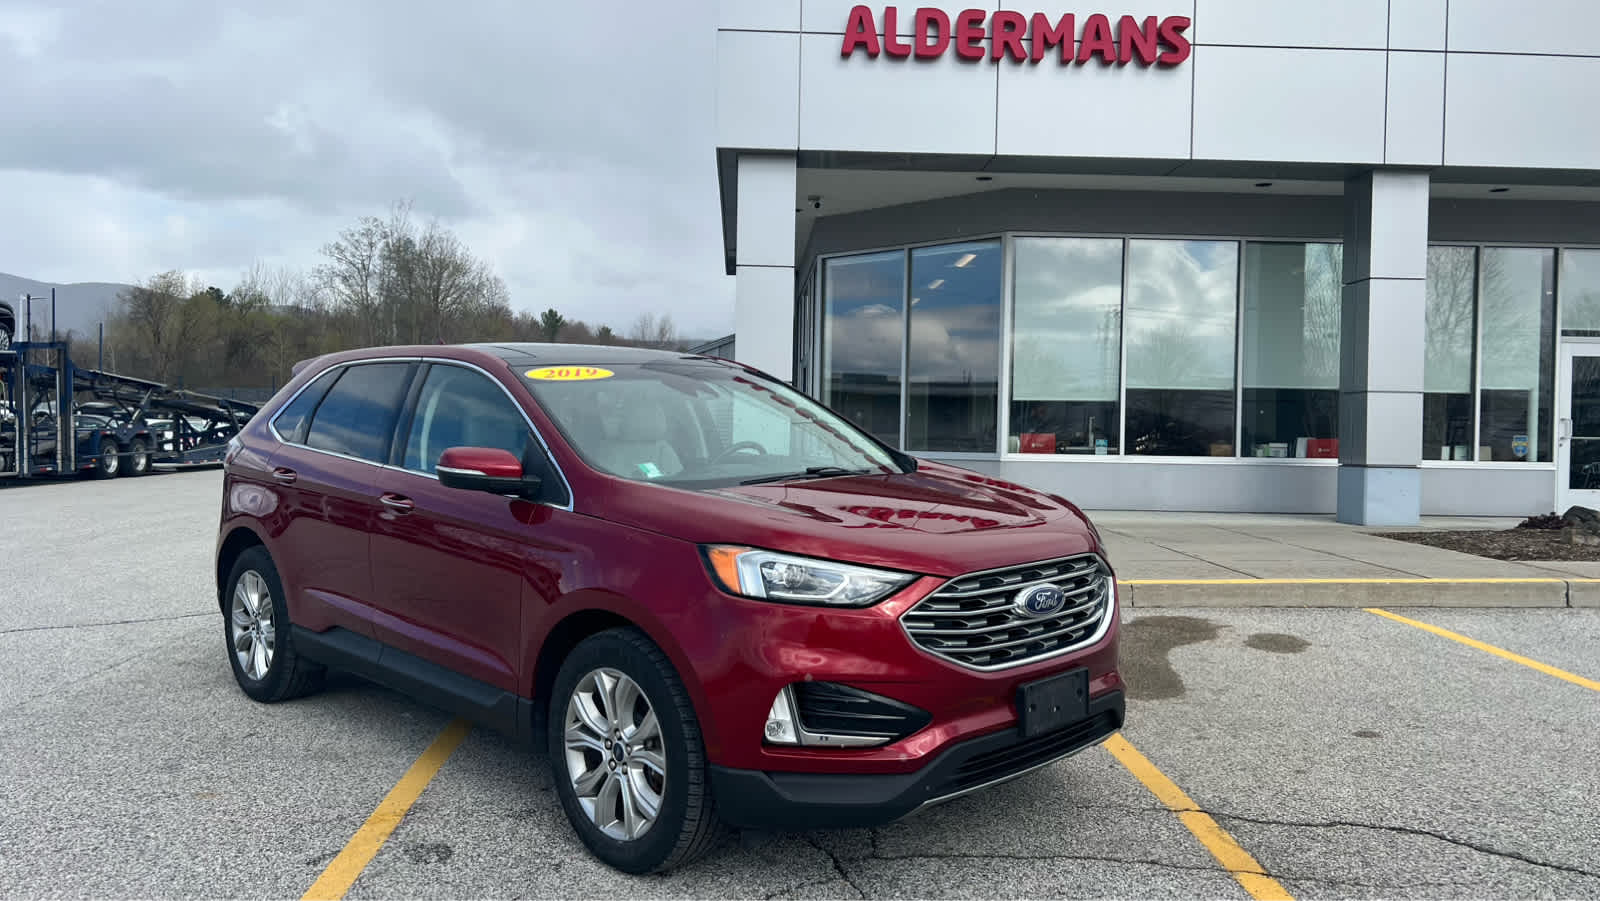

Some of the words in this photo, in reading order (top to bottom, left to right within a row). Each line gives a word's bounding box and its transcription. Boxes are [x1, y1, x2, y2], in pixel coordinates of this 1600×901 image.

[841, 5, 1191, 66] ALDERMANS
[543, 368, 598, 379] 2019
[1034, 591, 1058, 610] Ford
